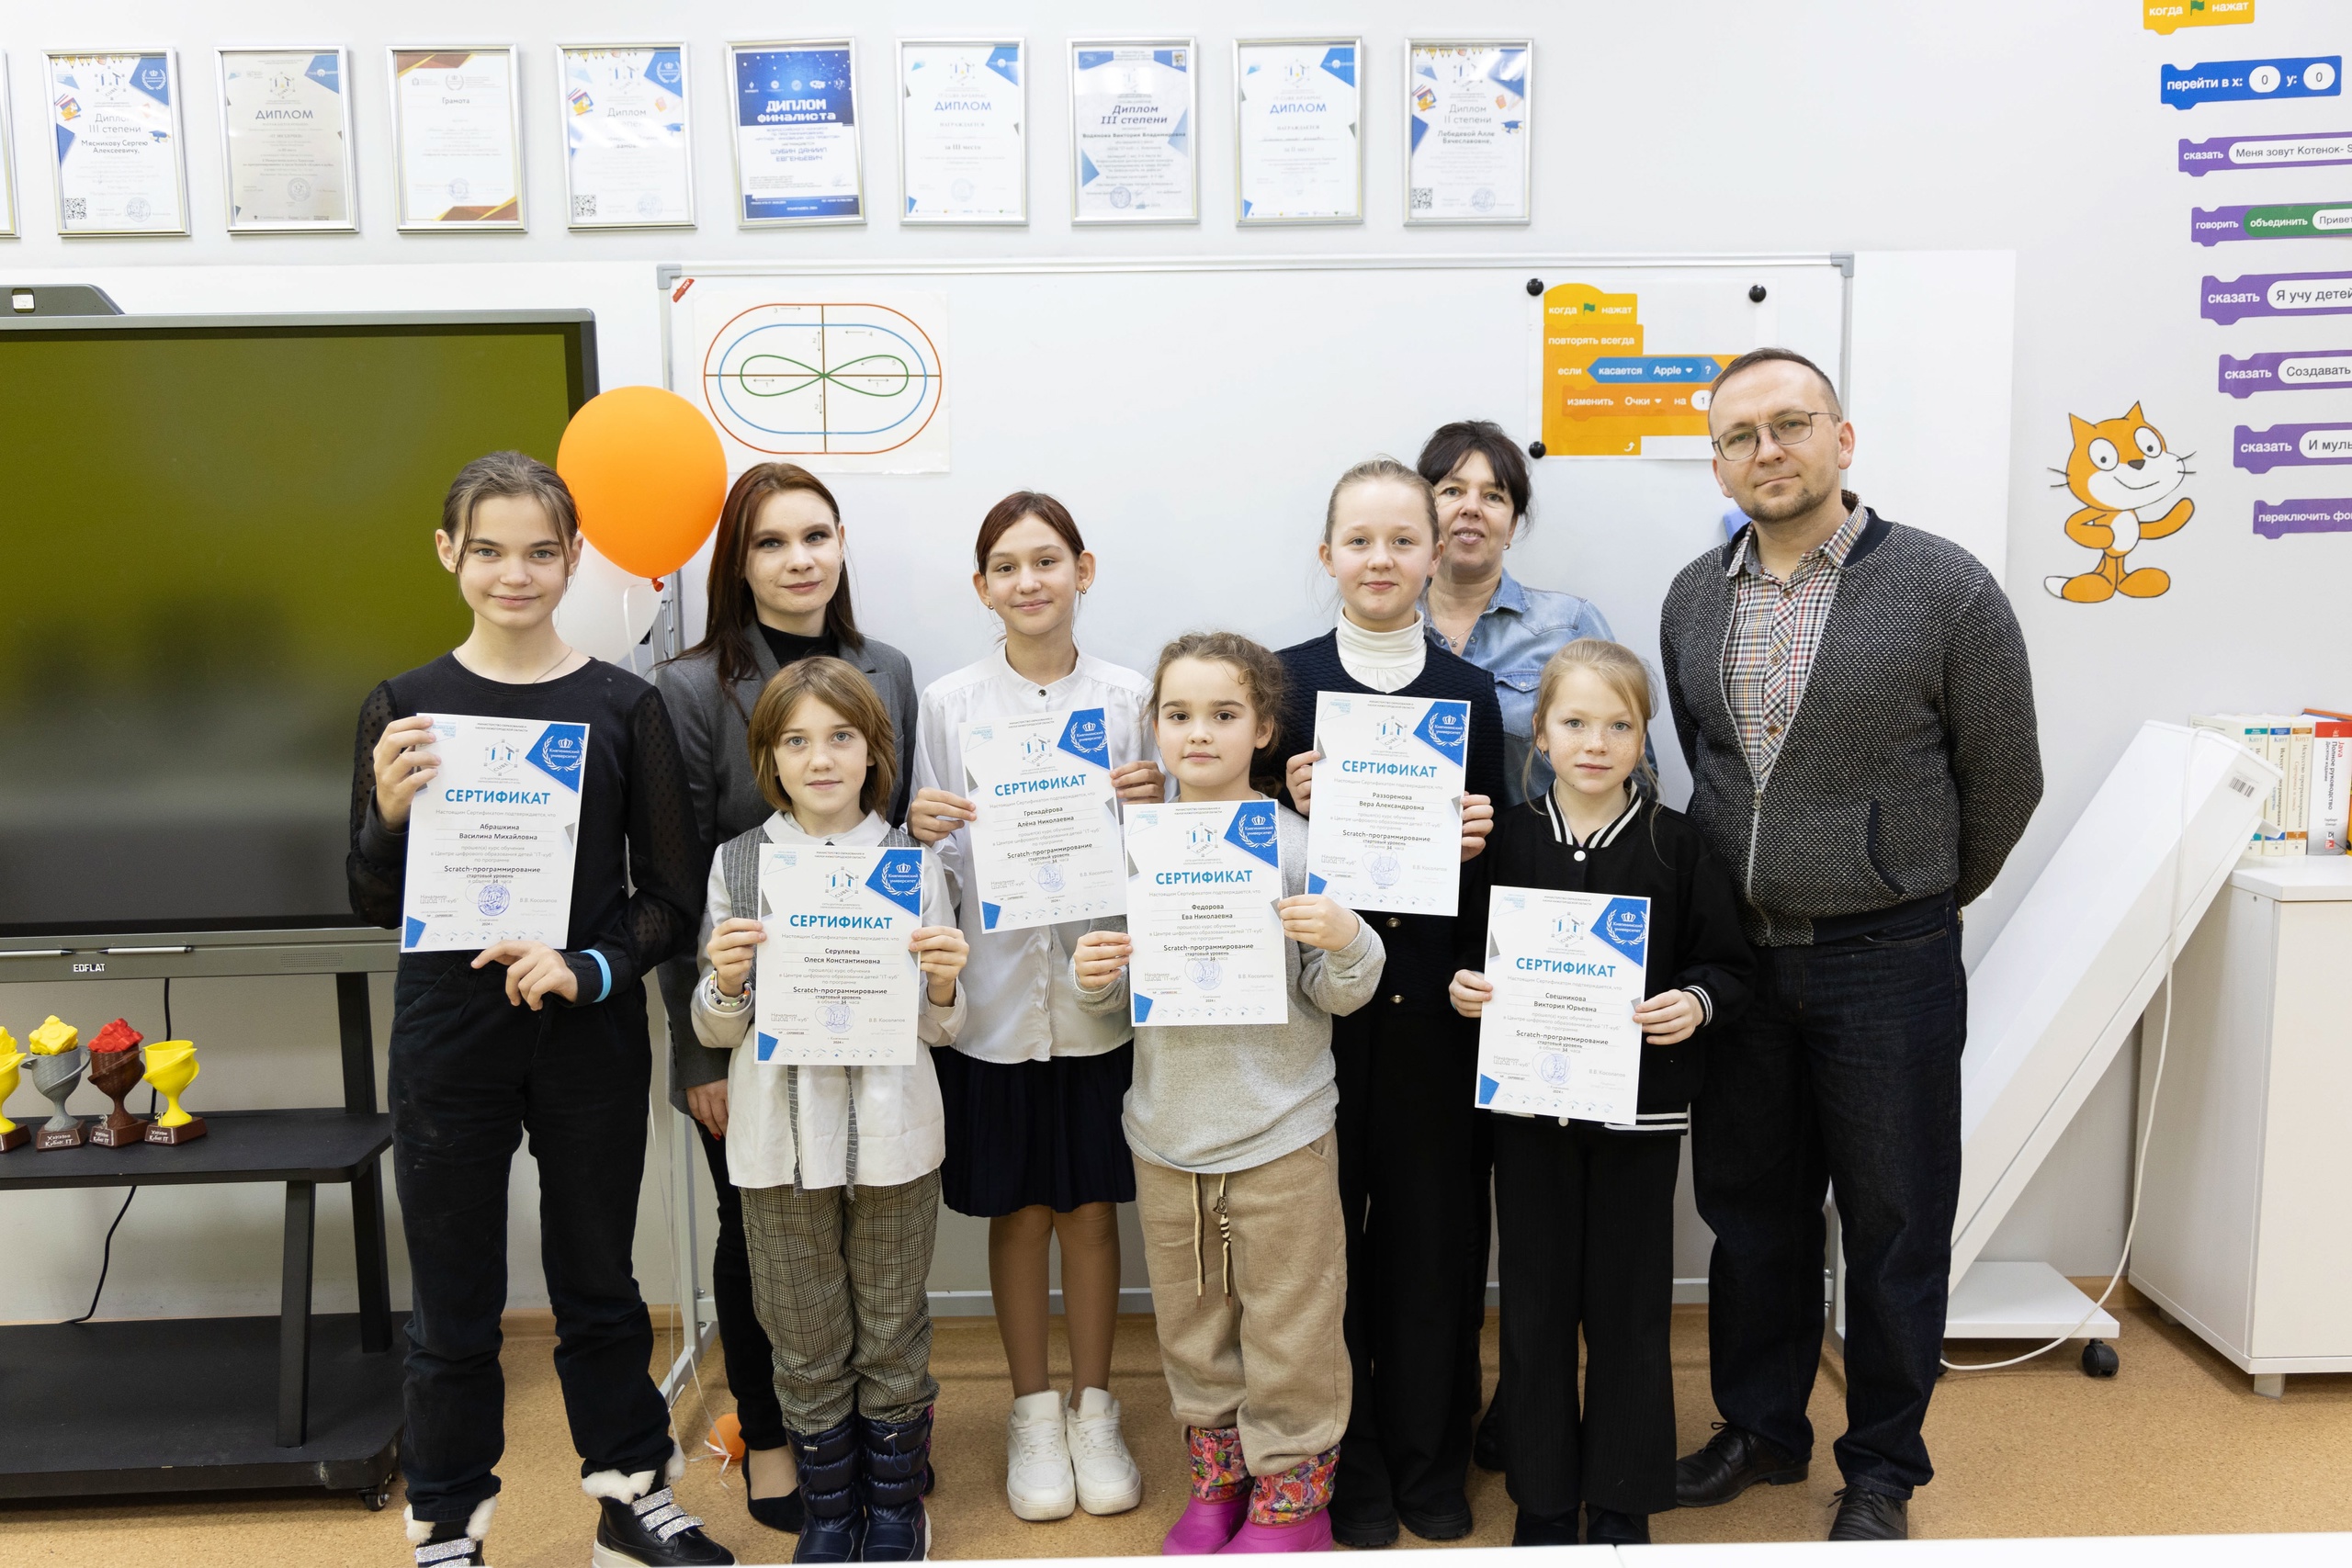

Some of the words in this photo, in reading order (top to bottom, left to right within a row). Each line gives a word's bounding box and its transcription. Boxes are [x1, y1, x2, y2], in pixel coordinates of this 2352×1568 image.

[2149, 6, 2183, 17] когда
[2212, 2, 2249, 13] нажат
[2167, 76, 2218, 91] перейти
[2222, 78, 2228, 87] в
[2261, 75, 2268, 85] 0
[2315, 72, 2323, 82] 0
[766, 99, 827, 112] ДИПЛОМ
[934, 101, 992, 111] ДИПЛОМ
[1112, 105, 1158, 115] Диплом
[1270, 103, 1327, 114] ДИПЛОМ
[1449, 104, 1486, 114] Диплом
[255, 110, 313, 120] ДИПЛОМ
[607, 108, 646, 117] Диплом
[2183, 150, 2224, 161] сказать
[2236, 148, 2263, 158] Меня
[2266, 147, 2294, 158] зовут
[2298, 145, 2344, 155] Котенок-
[2196, 220, 2239, 230] говорить
[2250, 217, 2308, 228] объединить
[2208, 292, 2260, 304] сказать
[2276, 290, 2286, 301] Я
[2289, 290, 2312, 303] учу
[1548, 306, 1577, 315] когда
[1602, 306, 1632, 314] нажат
[1548, 337, 1598, 346] повторять
[1601, 336, 1634, 346] всегда
[1558, 367, 1582, 376] если
[1598, 367, 1642, 376] касается
[1653, 366, 1681, 377] Apple
[1705, 365, 1711, 375] ?
[2225, 369, 2272, 379] сказать
[2286, 365, 2351, 378] Создавать
[1567, 397, 1614, 406] изменить
[1625, 396, 1650, 406] Очки
[2240, 442, 2292, 453] сказать
[2309, 440, 2318, 450] И
[2258, 512, 2330, 523] переключить
[1342, 760, 1437, 778] СЕРТИФИКАТ
[995, 774, 1086, 796] СЕРТИФИКАТ
[445, 789, 550, 804] СЕРТИФИКАТ
[1024, 807, 1063, 816] Гренадёрова
[1376, 802, 1424, 811] Александровна
[1038, 816, 1074, 825] Николаевна
[1343, 830, 1431, 842] Scratch-программирование
[1007, 843, 1092, 859] Scratch-программирование
[1156, 870, 1253, 885] СЕРТИФИКАТ
[790, 915, 893, 929] СЕРТИФИКАТ
[73, 963, 105, 972] EDFLAT
[1516, 957, 1616, 977] СЕРТИФИКАТ
[1546, 992, 1586, 1002] Свешникова
[1534, 1001, 1565, 1009] Виктория
[1516, 1030, 1608, 1045] Scratch-программирование
